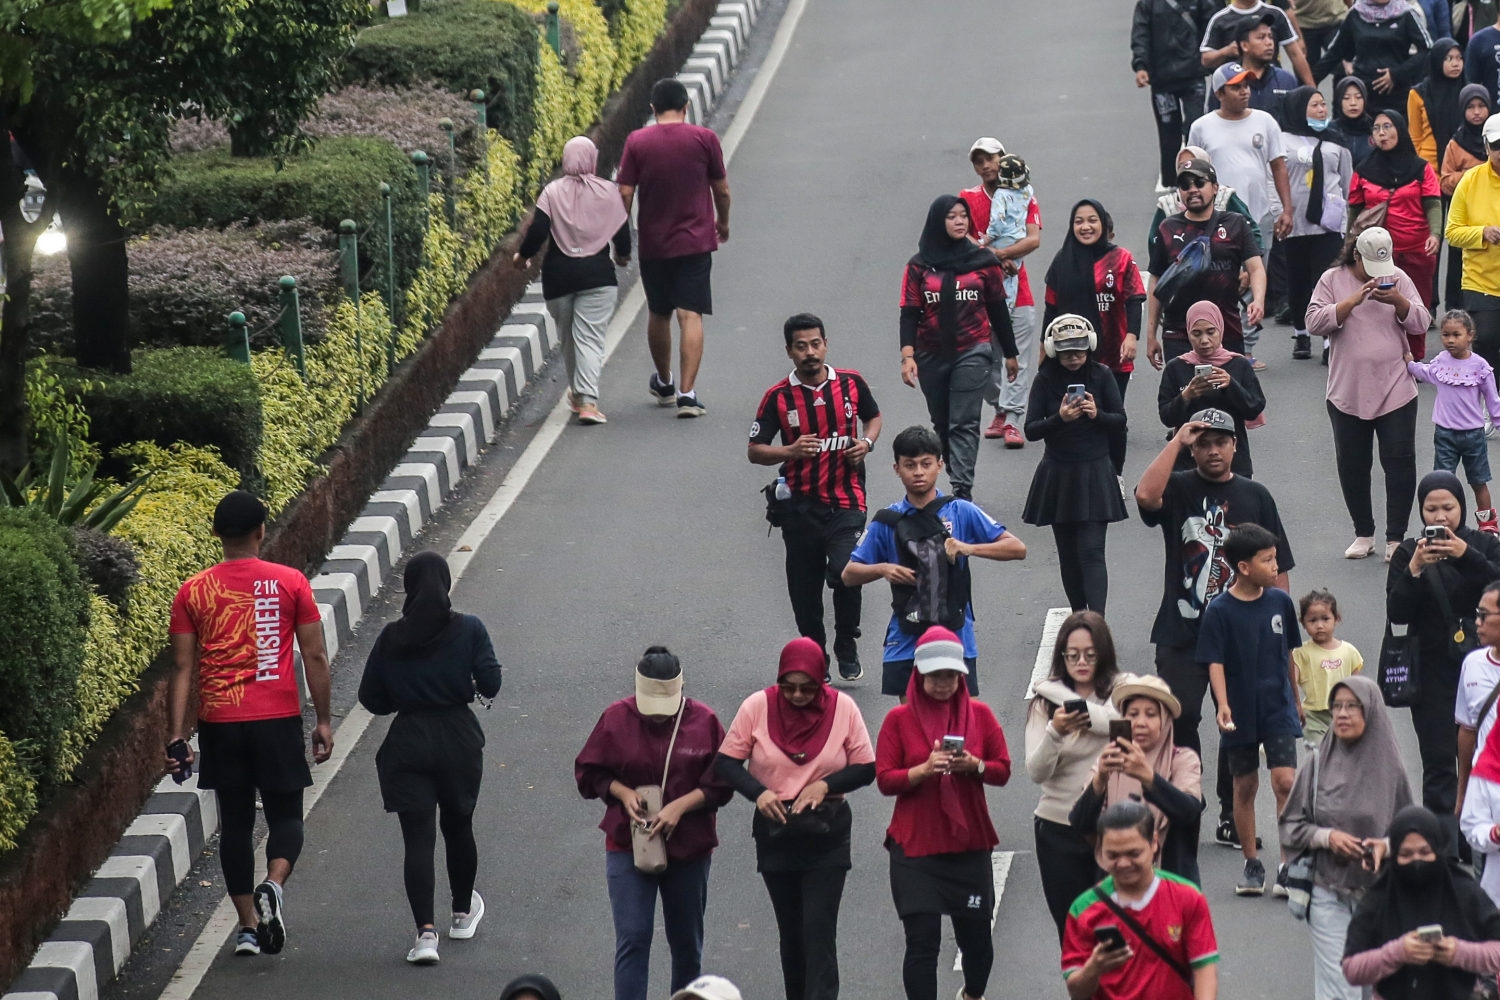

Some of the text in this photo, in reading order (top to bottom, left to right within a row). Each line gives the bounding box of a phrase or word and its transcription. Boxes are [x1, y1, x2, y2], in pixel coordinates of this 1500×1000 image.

[924, 290, 979, 304] Emates
[816, 432, 849, 453] win
[253, 579, 280, 596] 21K
[254, 597, 281, 682] FNISHER
